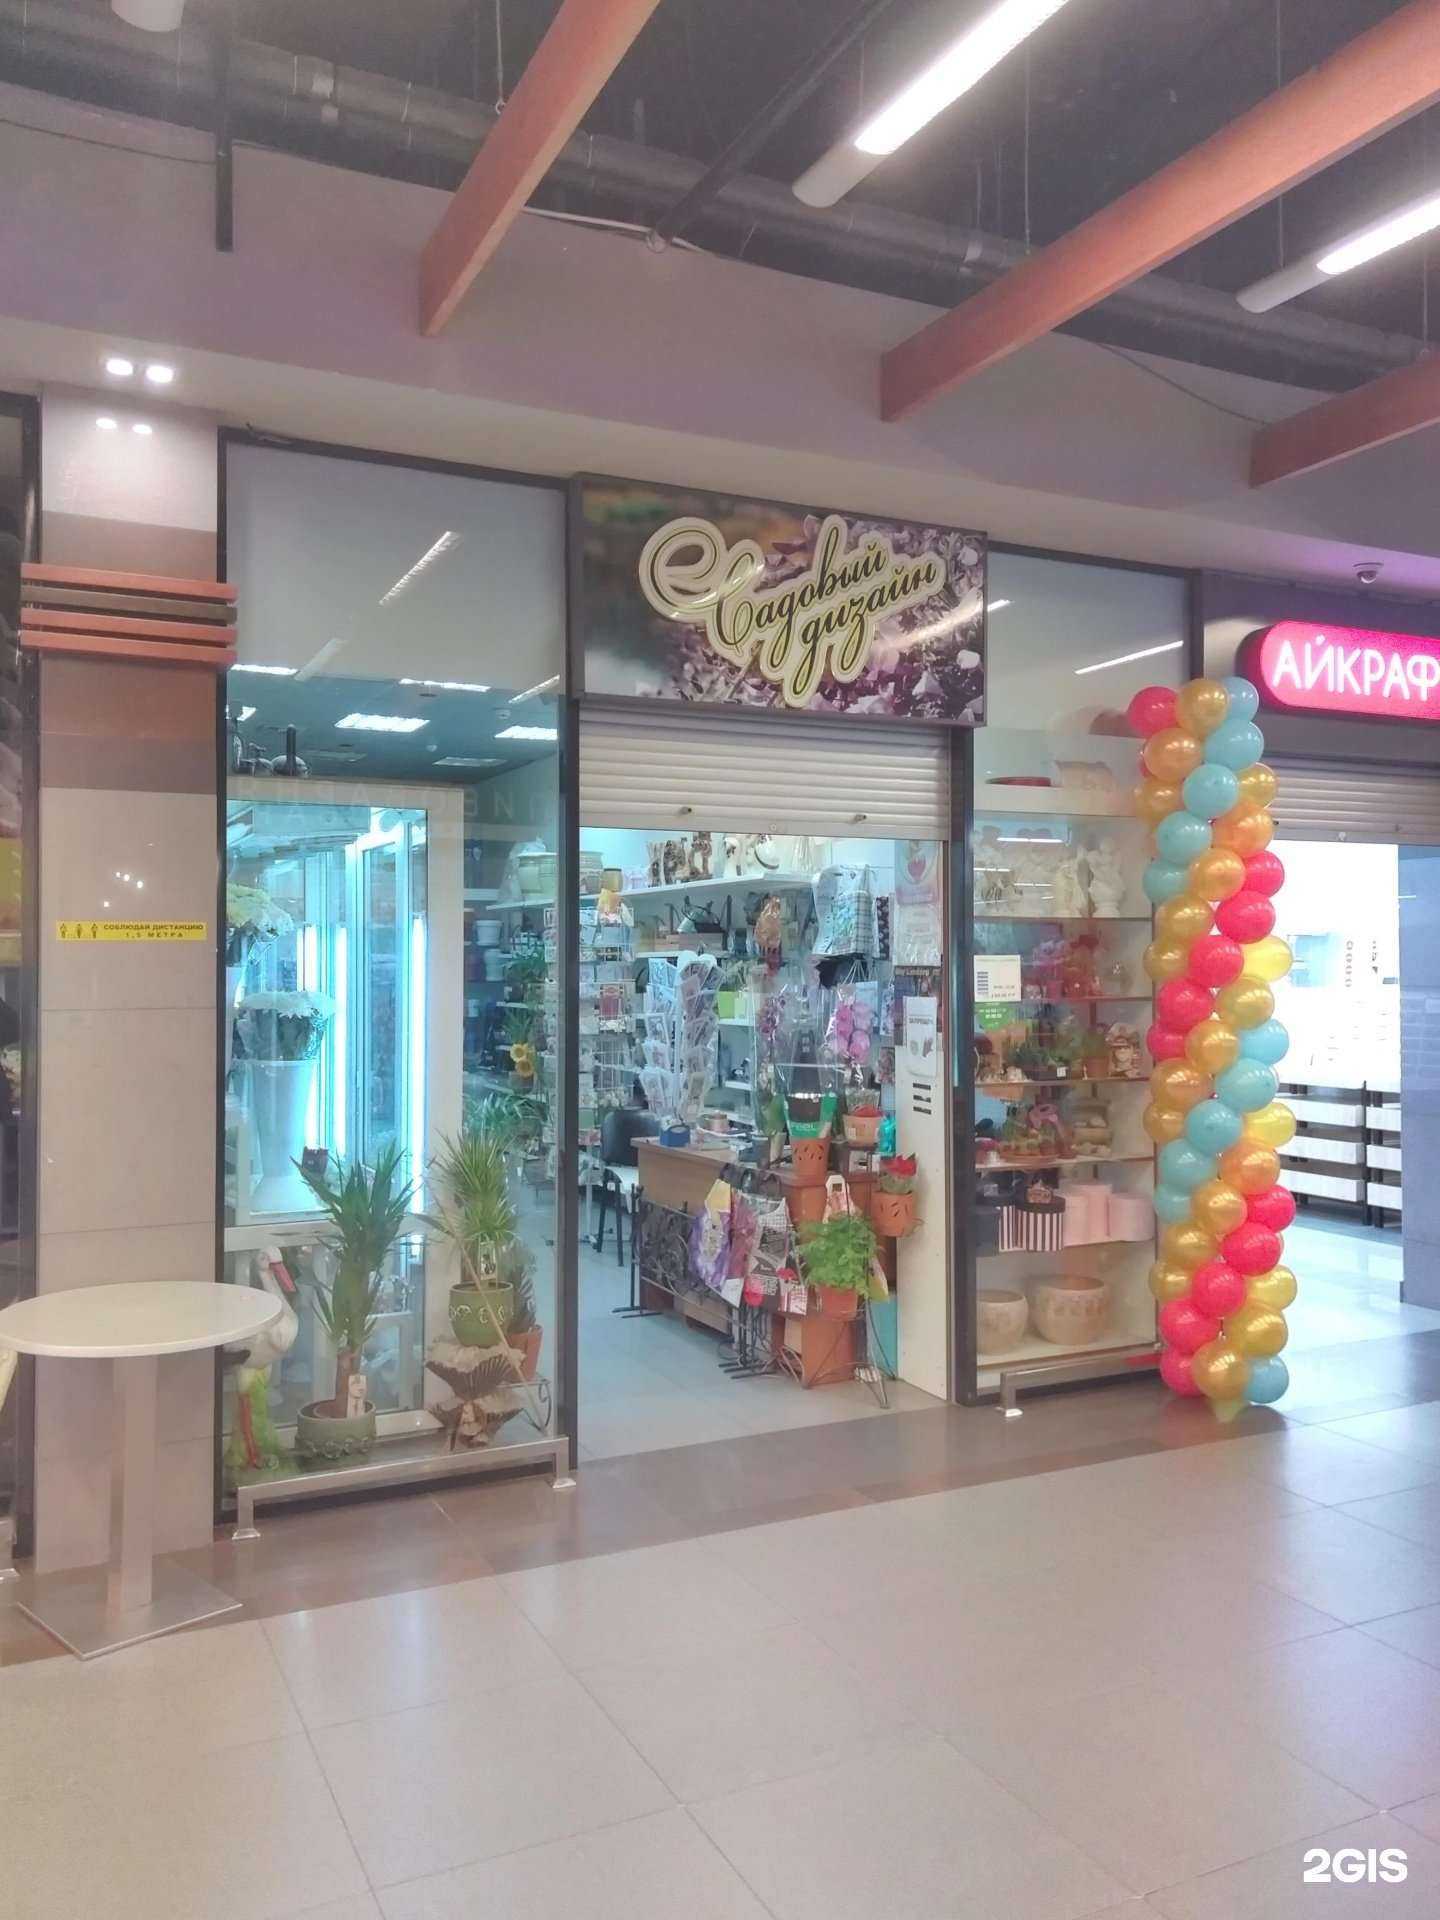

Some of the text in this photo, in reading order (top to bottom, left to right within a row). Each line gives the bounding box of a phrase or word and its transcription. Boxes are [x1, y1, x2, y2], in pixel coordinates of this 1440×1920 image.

[645, 521, 889, 671] Садовый
[790, 563, 939, 697] дизайн
[1271, 634, 1440, 702] АЙКРАФ
[152, 923, 204, 931] ДИСТАНЦИЮ
